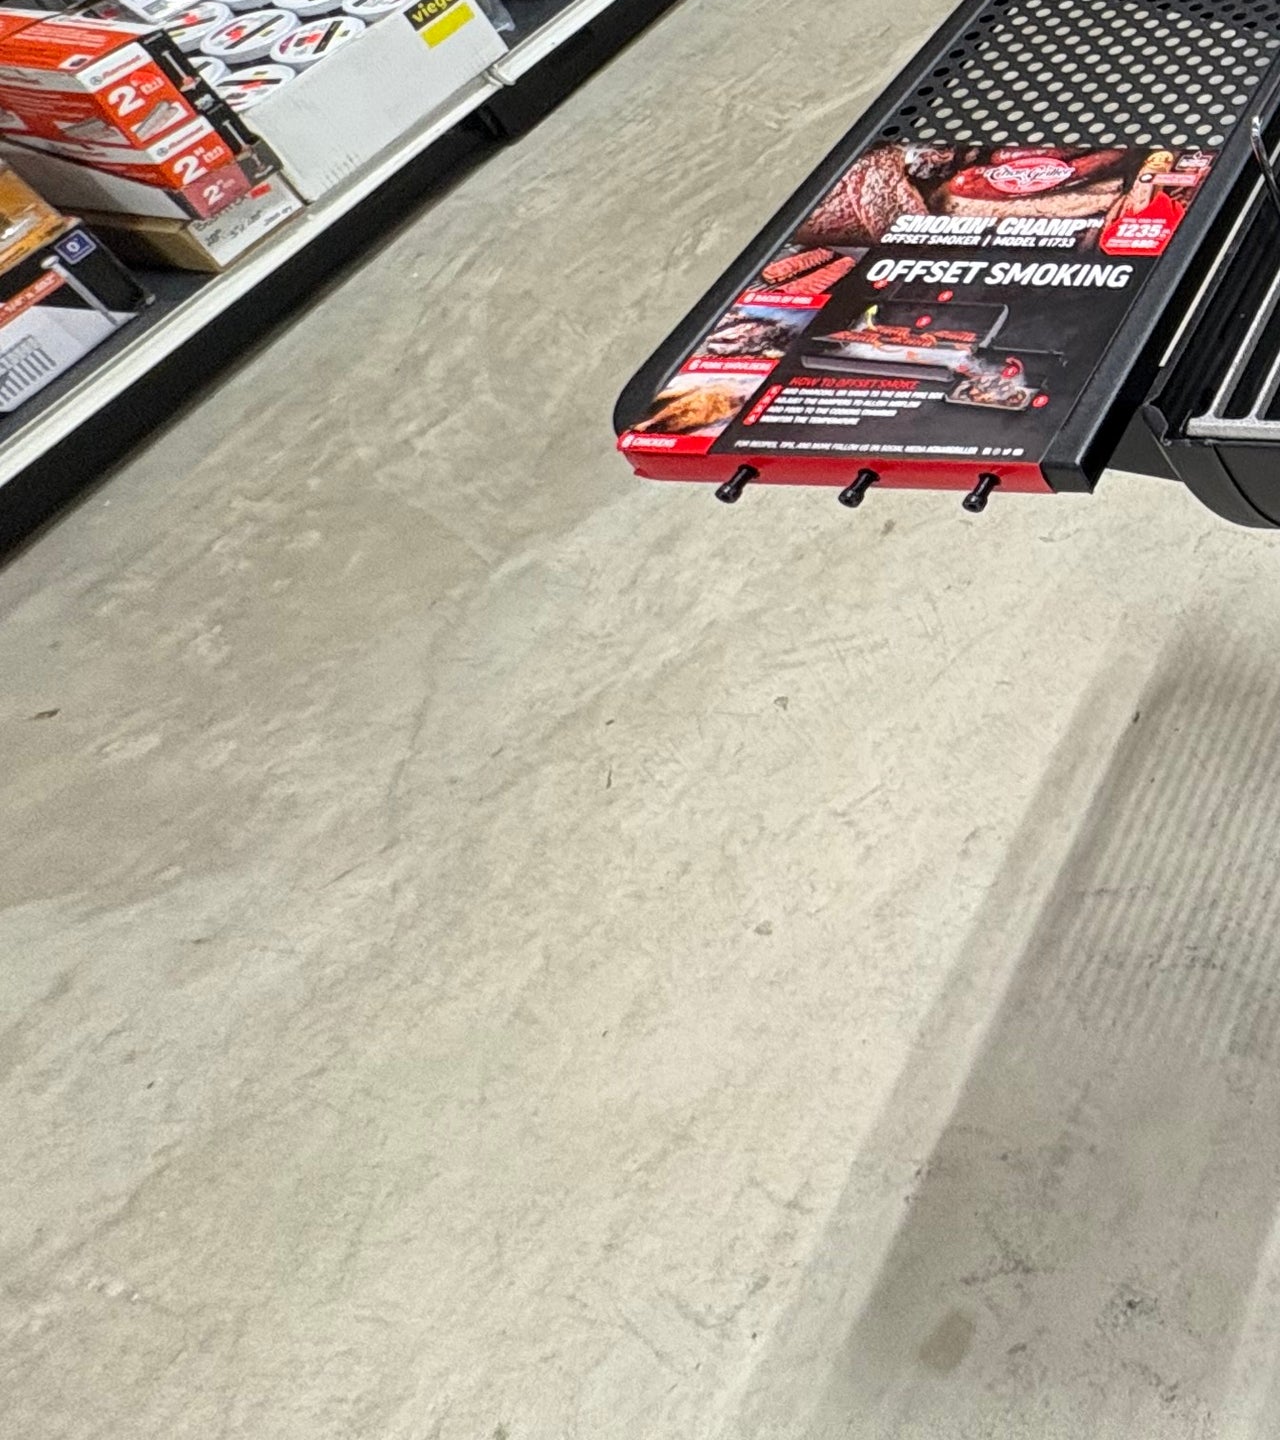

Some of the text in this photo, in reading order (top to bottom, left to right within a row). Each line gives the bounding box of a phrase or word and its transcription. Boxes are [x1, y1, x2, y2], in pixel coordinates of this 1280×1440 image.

[890, 214, 998, 235] SMOKIN'
[1116, 223, 1164, 238] 1235
[880, 233, 928, 245] OFFSET
[928, 234, 981, 246] SMOKER
[991, 236, 1036, 248] MODEL
[866, 258, 1134, 289] OFFSET SMOKING
[789, 377, 818, 387] HOW
[835, 379, 878, 389] OFFSET
